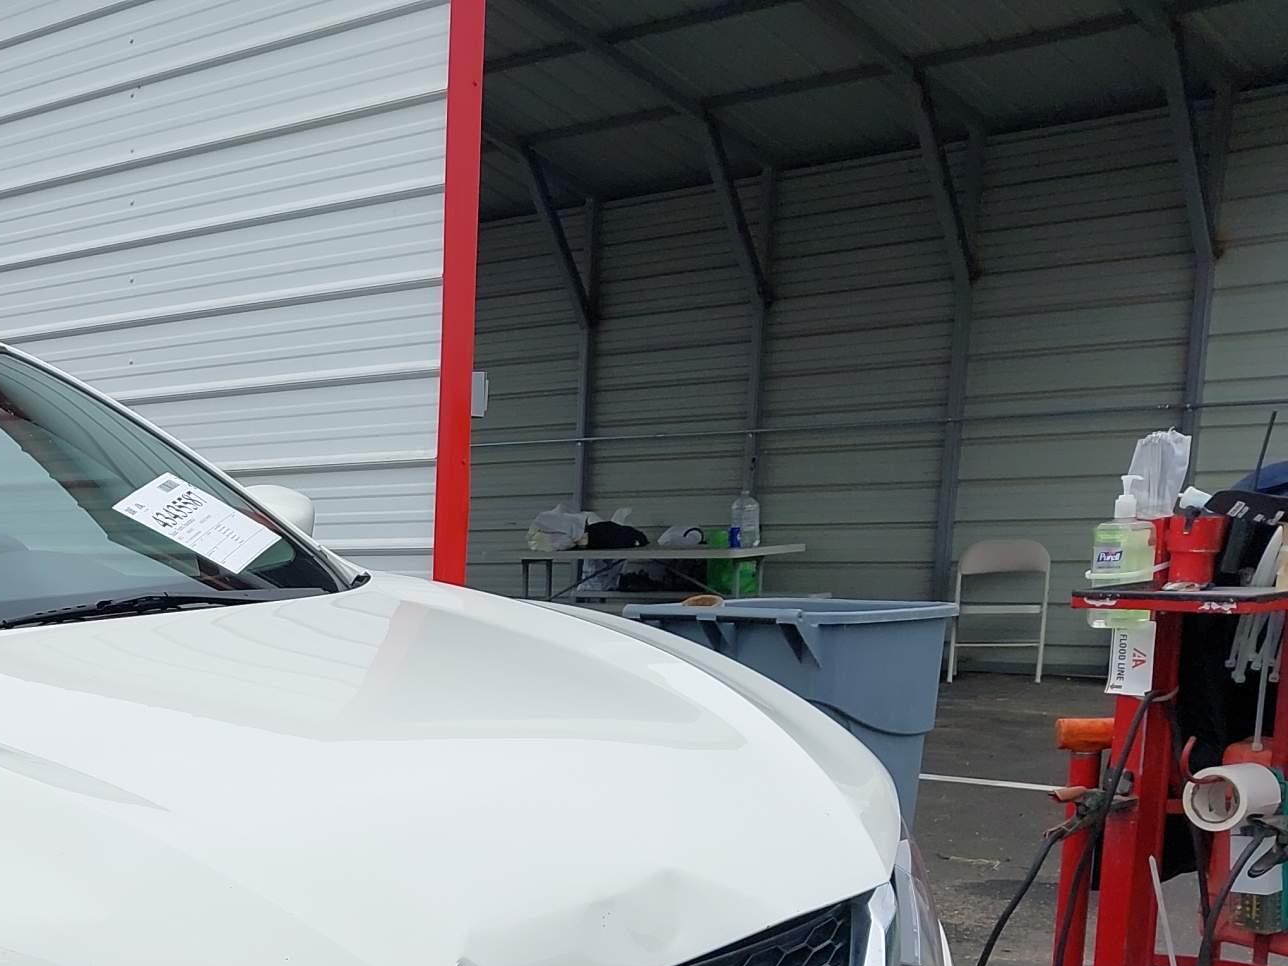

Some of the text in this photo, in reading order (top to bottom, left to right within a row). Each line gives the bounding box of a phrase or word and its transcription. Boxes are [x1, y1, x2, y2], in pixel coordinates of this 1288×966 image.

[151, 490, 207, 528] 43435587
[1116, 633, 1128, 682] FLOOD LINE
